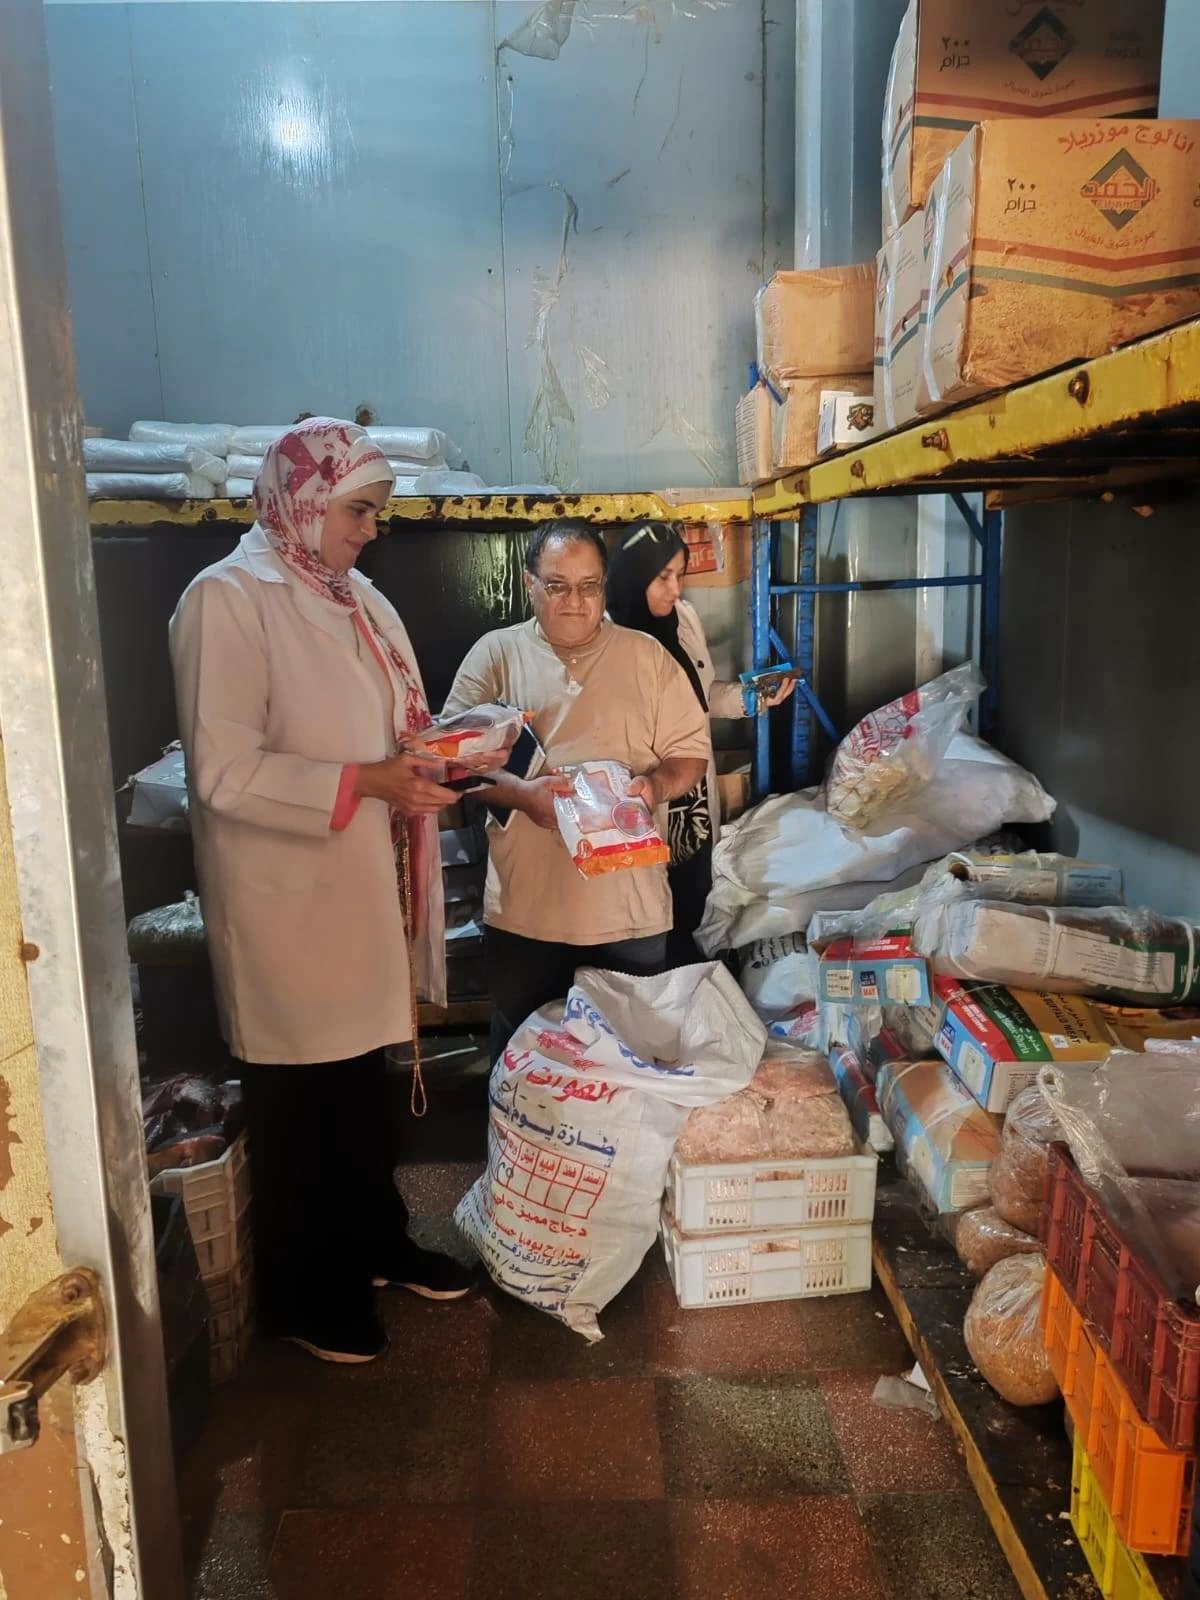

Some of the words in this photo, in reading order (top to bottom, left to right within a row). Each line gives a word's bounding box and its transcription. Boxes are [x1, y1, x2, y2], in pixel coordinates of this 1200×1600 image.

[939, 54, 970, 72] جرام
[1007, 178, 1036, 192] ٢٠٠
[1004, 198, 1037, 213] جرام
[1061, 1021, 1082, 1046] MEAT
